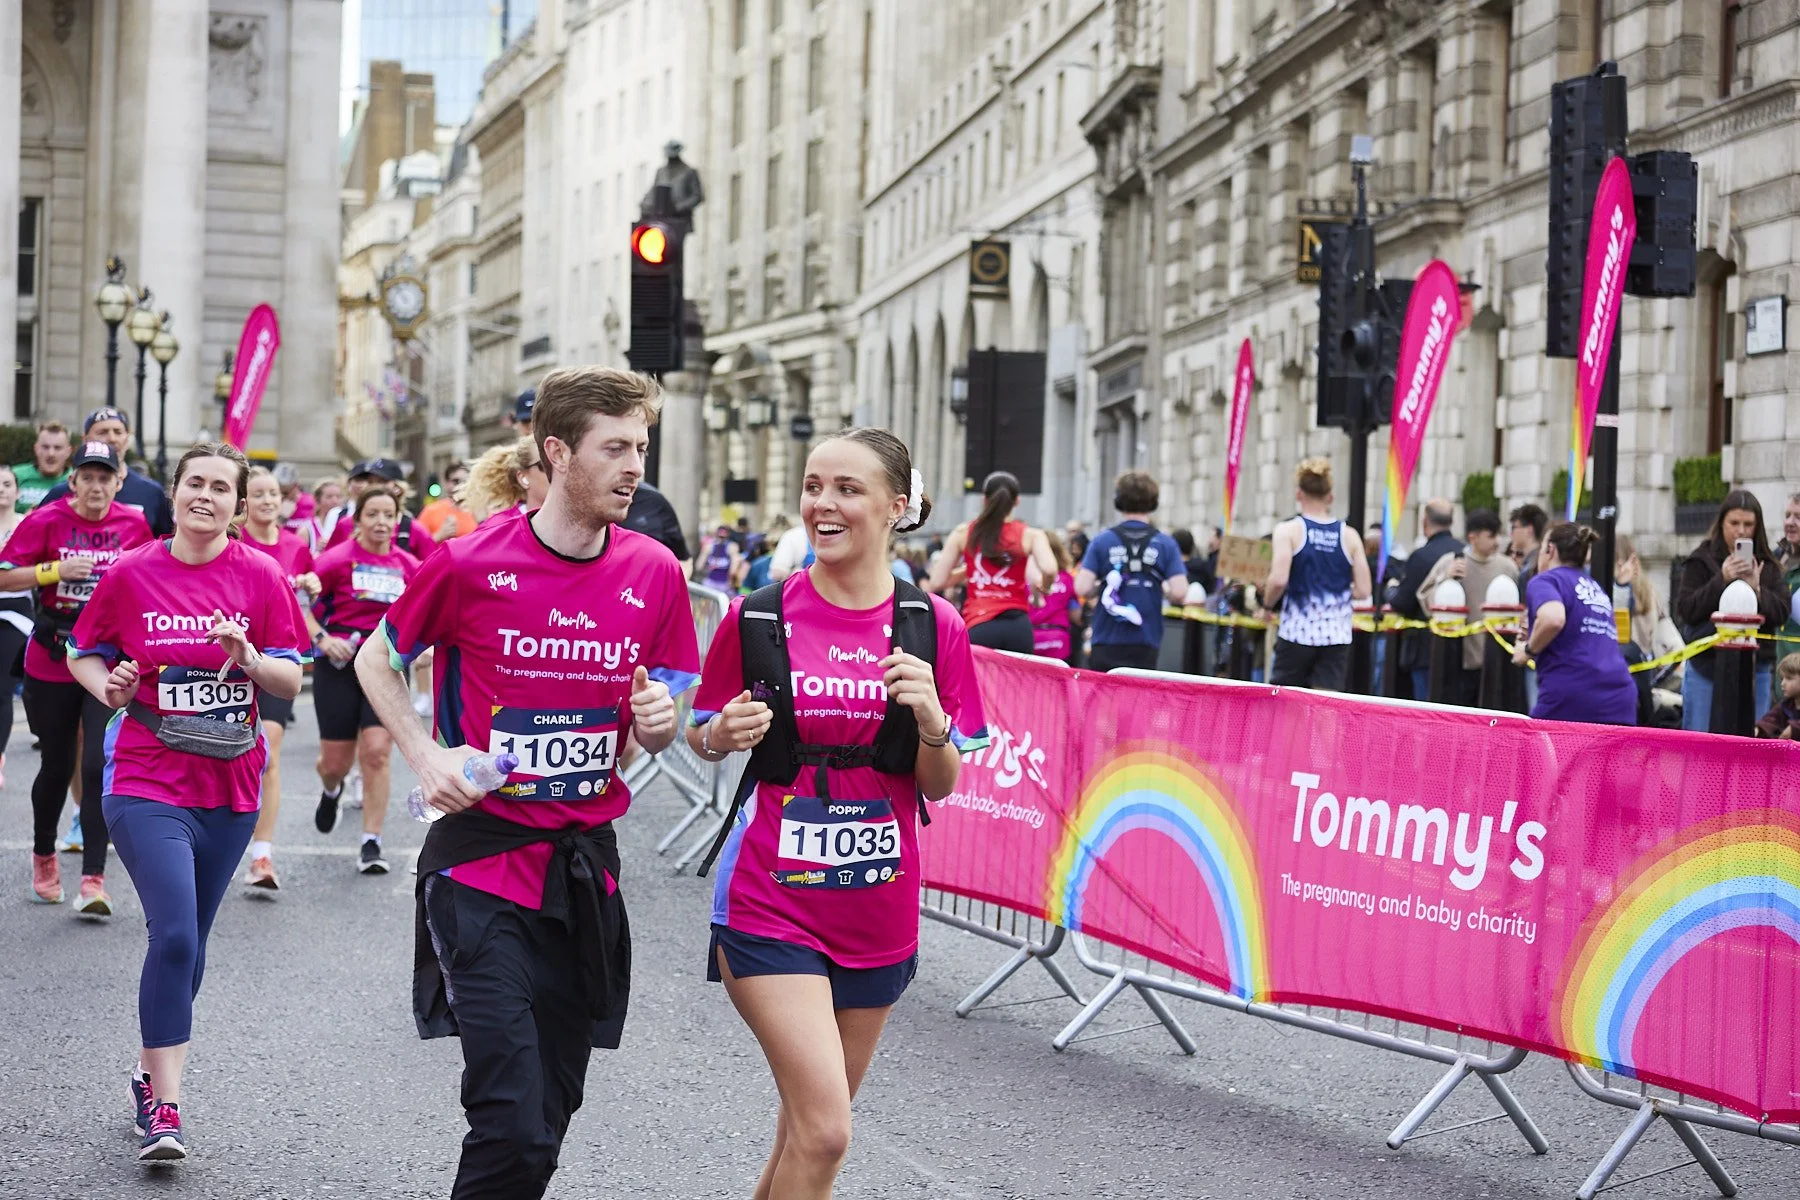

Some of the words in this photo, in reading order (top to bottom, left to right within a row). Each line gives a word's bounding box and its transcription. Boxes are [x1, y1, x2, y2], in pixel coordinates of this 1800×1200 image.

[1583, 203, 1624, 368] Tommy's
[1399, 295, 1448, 424] Tommy's
[142, 611, 251, 632] Tomm's
[156, 637, 194, 646] pregnancy
[497, 628, 641, 670] Tommy's
[495, 664, 512, 675] The
[513, 669, 564, 681] pregnancy
[566, 671, 585, 681] and
[586, 672, 609, 684] baby
[790, 671, 888, 702] Tomm
[166, 683, 248, 708] 11305
[533, 714, 584, 725] CHARLIE
[804, 709, 852, 719] pregnancy
[853, 710, 872, 719] and
[873, 711, 886, 721] ba
[500, 735, 610, 769] 11034
[828, 805, 867, 815] POPPY
[947, 790, 972, 809] and
[972, 790, 1001, 820] baby
[1000, 799, 1046, 829] charity
[791, 825, 896, 857] 11035
[1290, 771, 1548, 891] Tommy's
[1281, 873, 1301, 896] The
[1303, 881, 1376, 915] pregnancy
[1379, 894, 1412, 918] and
[1415, 896, 1462, 931] baby
[1467, 906, 1537, 945] charity
